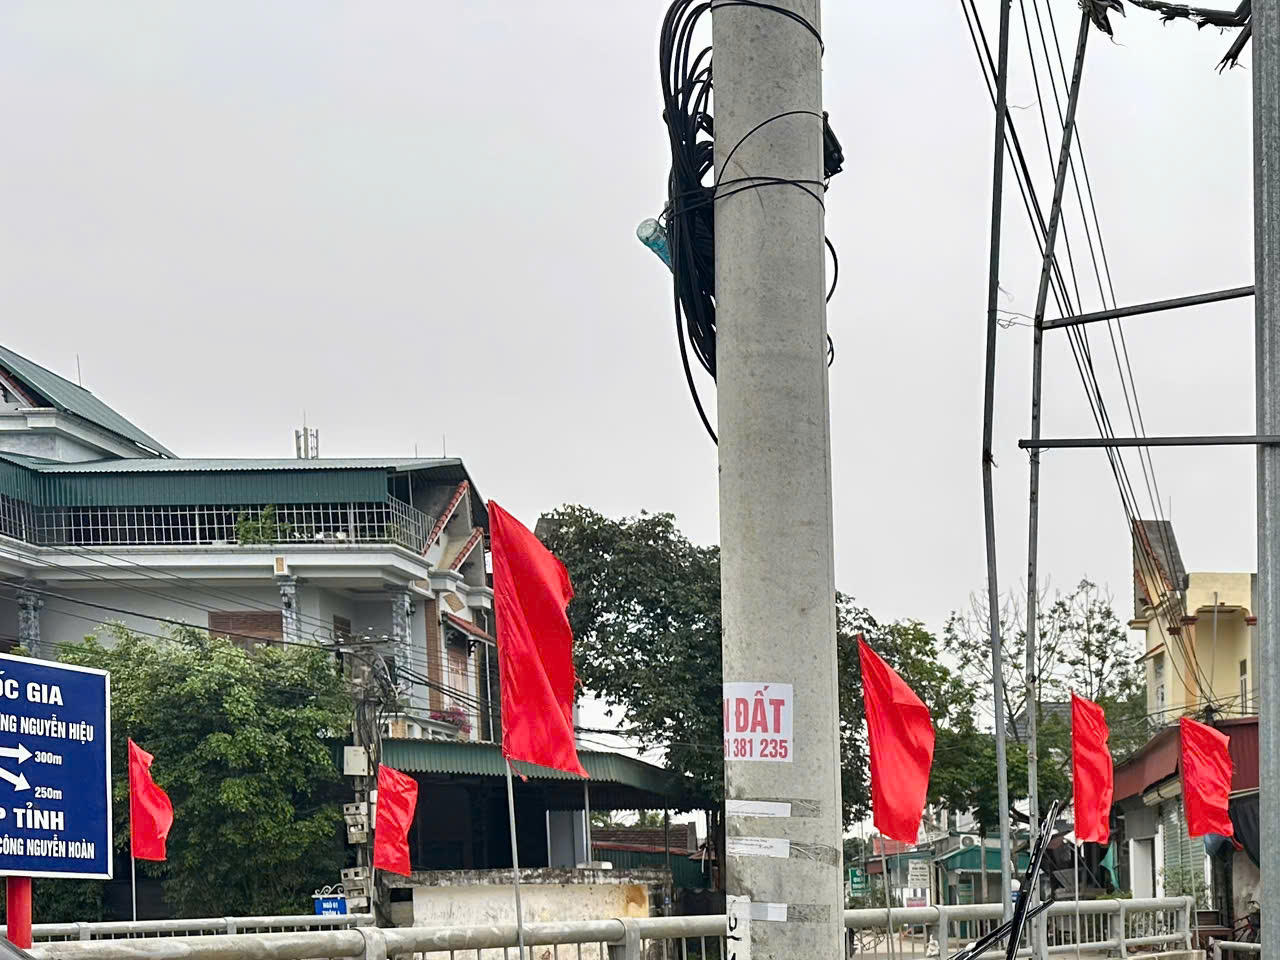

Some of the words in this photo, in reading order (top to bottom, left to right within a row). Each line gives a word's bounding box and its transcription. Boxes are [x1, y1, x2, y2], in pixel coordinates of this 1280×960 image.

[26, 682, 64, 706] GIA
[735, 685, 785, 733] ĐẤT
[20, 714, 66, 739] NGUYỄN
[69, 721, 94, 744] HIỆU
[34, 751, 63, 765] 300m
[734, 738, 753, 758] 381
[760, 738, 788, 759] 235
[34, 786, 63, 799] 250m
[13, 802, 65, 831] TỈNH
[26, 834, 66, 857] NGUYỄN
[68, 838, 95, 859] HOÀN
